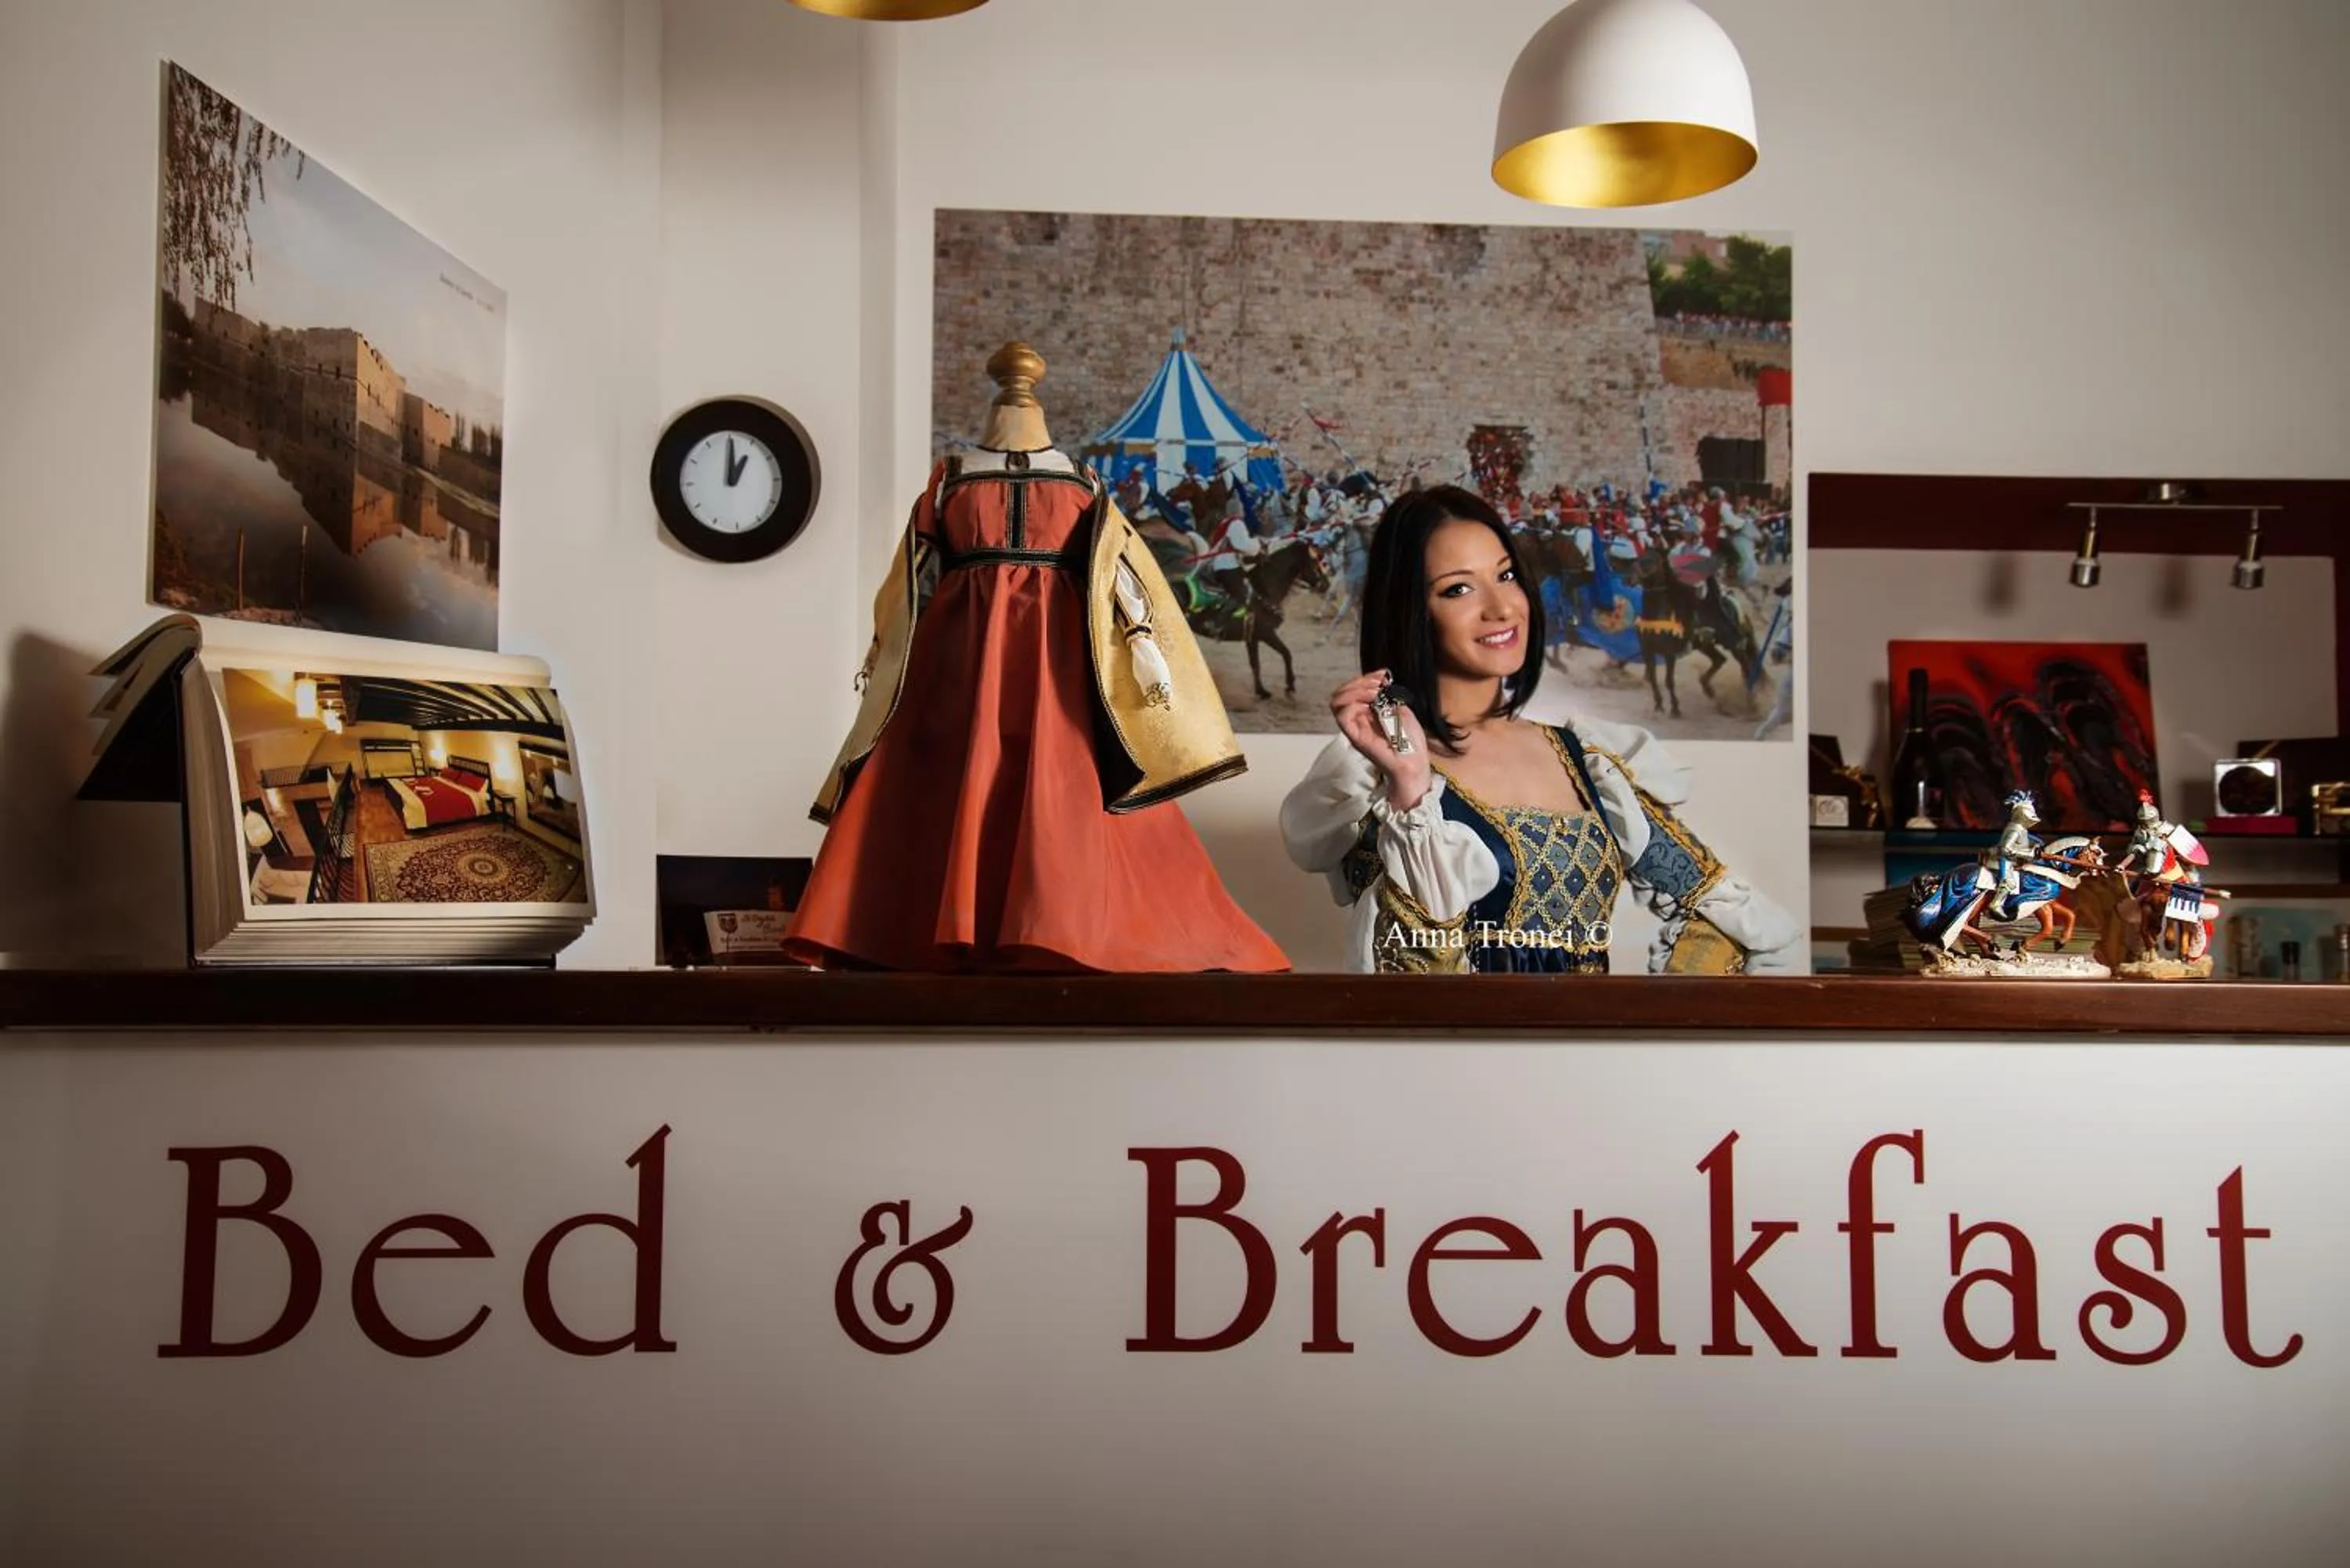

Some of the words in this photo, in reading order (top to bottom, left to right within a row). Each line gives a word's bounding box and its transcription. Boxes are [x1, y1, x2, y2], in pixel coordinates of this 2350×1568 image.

[157, 1122, 677, 1358] Bed
[834, 1199, 974, 1356] &
[1126, 1128, 2302, 1367] Breakfast
